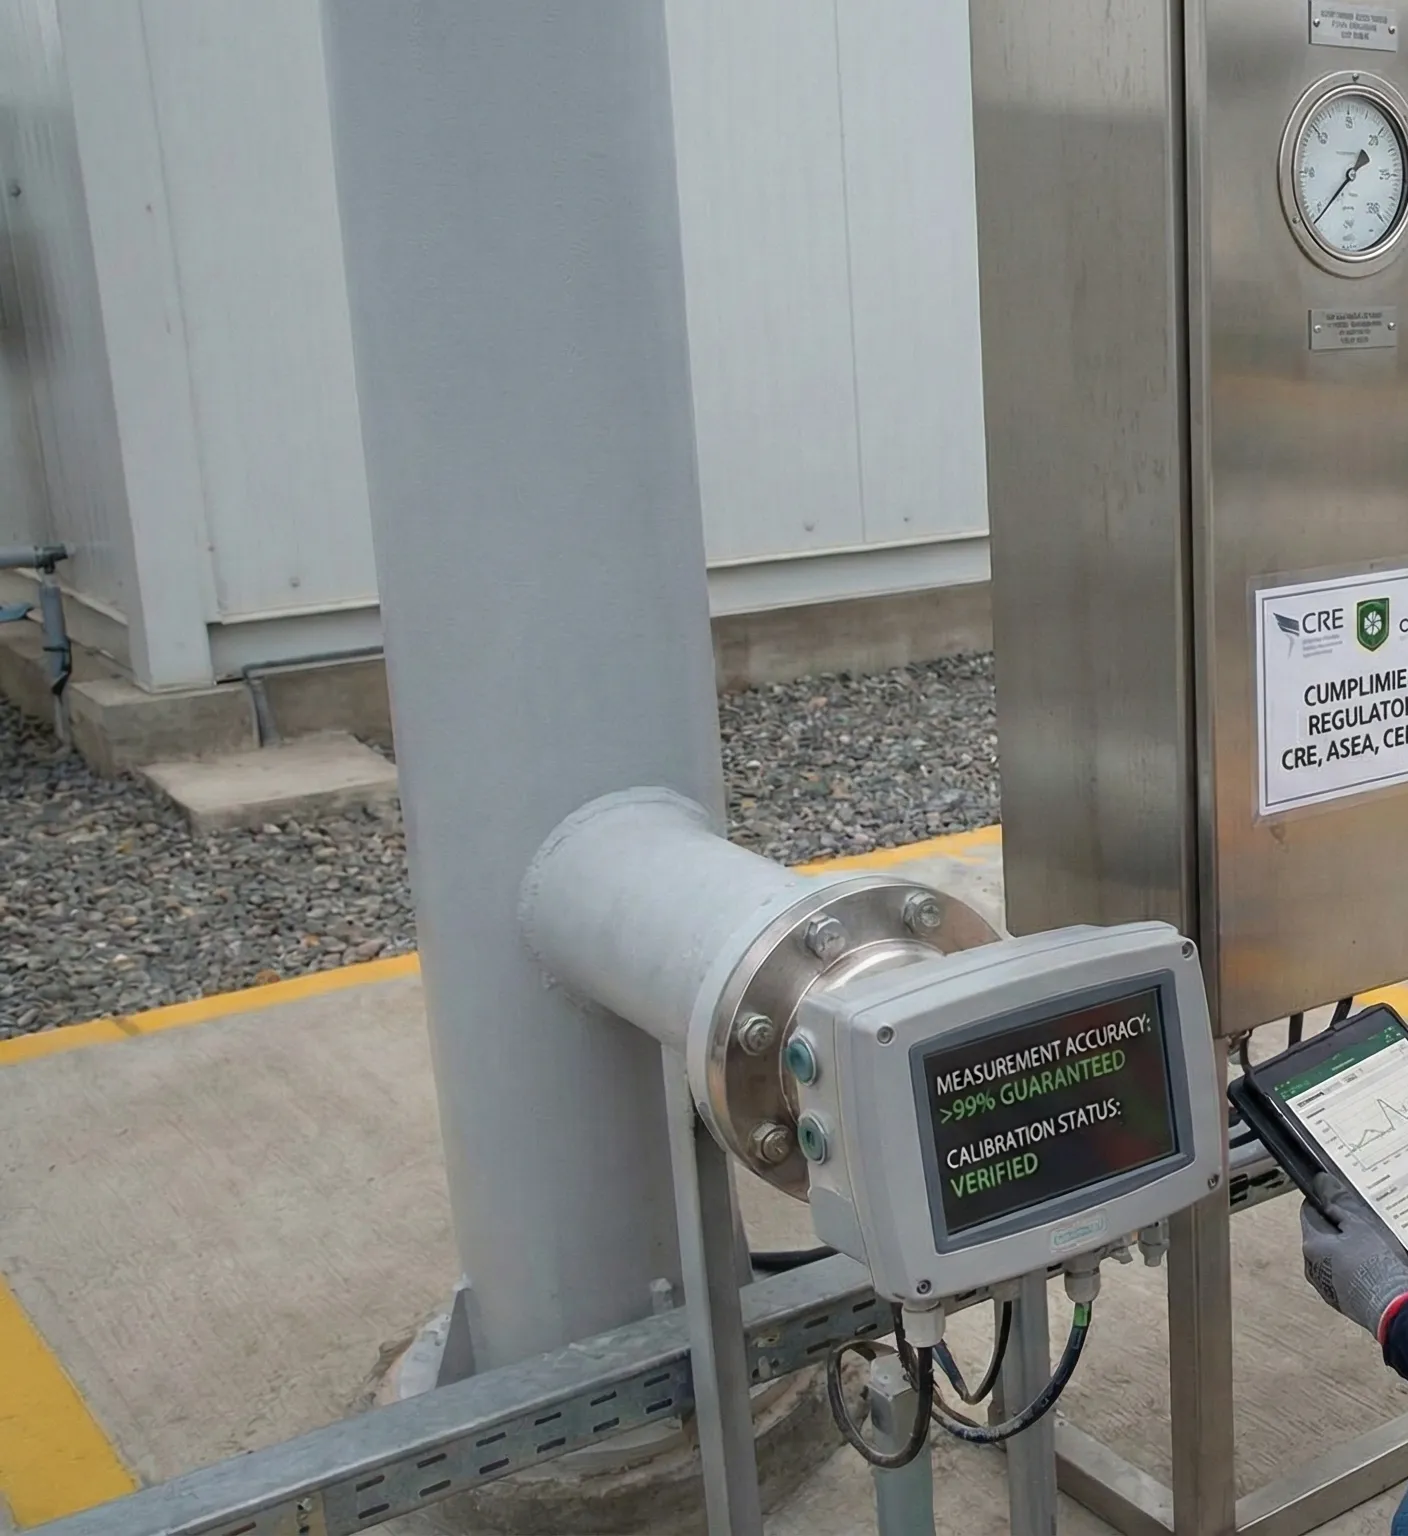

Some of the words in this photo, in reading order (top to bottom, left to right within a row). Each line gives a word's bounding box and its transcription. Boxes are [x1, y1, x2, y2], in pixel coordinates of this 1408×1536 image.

[1302, 608, 1344, 634] CRE
[1281, 744, 1323, 771] CRE,
[1326, 733, 1379, 762] ASEA,
[936, 1040, 1061, 1095] MEASUREMENT
[1066, 1013, 1152, 1057] ACCURACY:
[940, 1090, 996, 1124] >99%
[1000, 1050, 1126, 1105] GUARANTEED
[946, 1118, 1055, 1169] CALIBRATION
[1058, 1098, 1122, 1133] STATUS:
[950, 1152, 1039, 1198] VERIFIED
